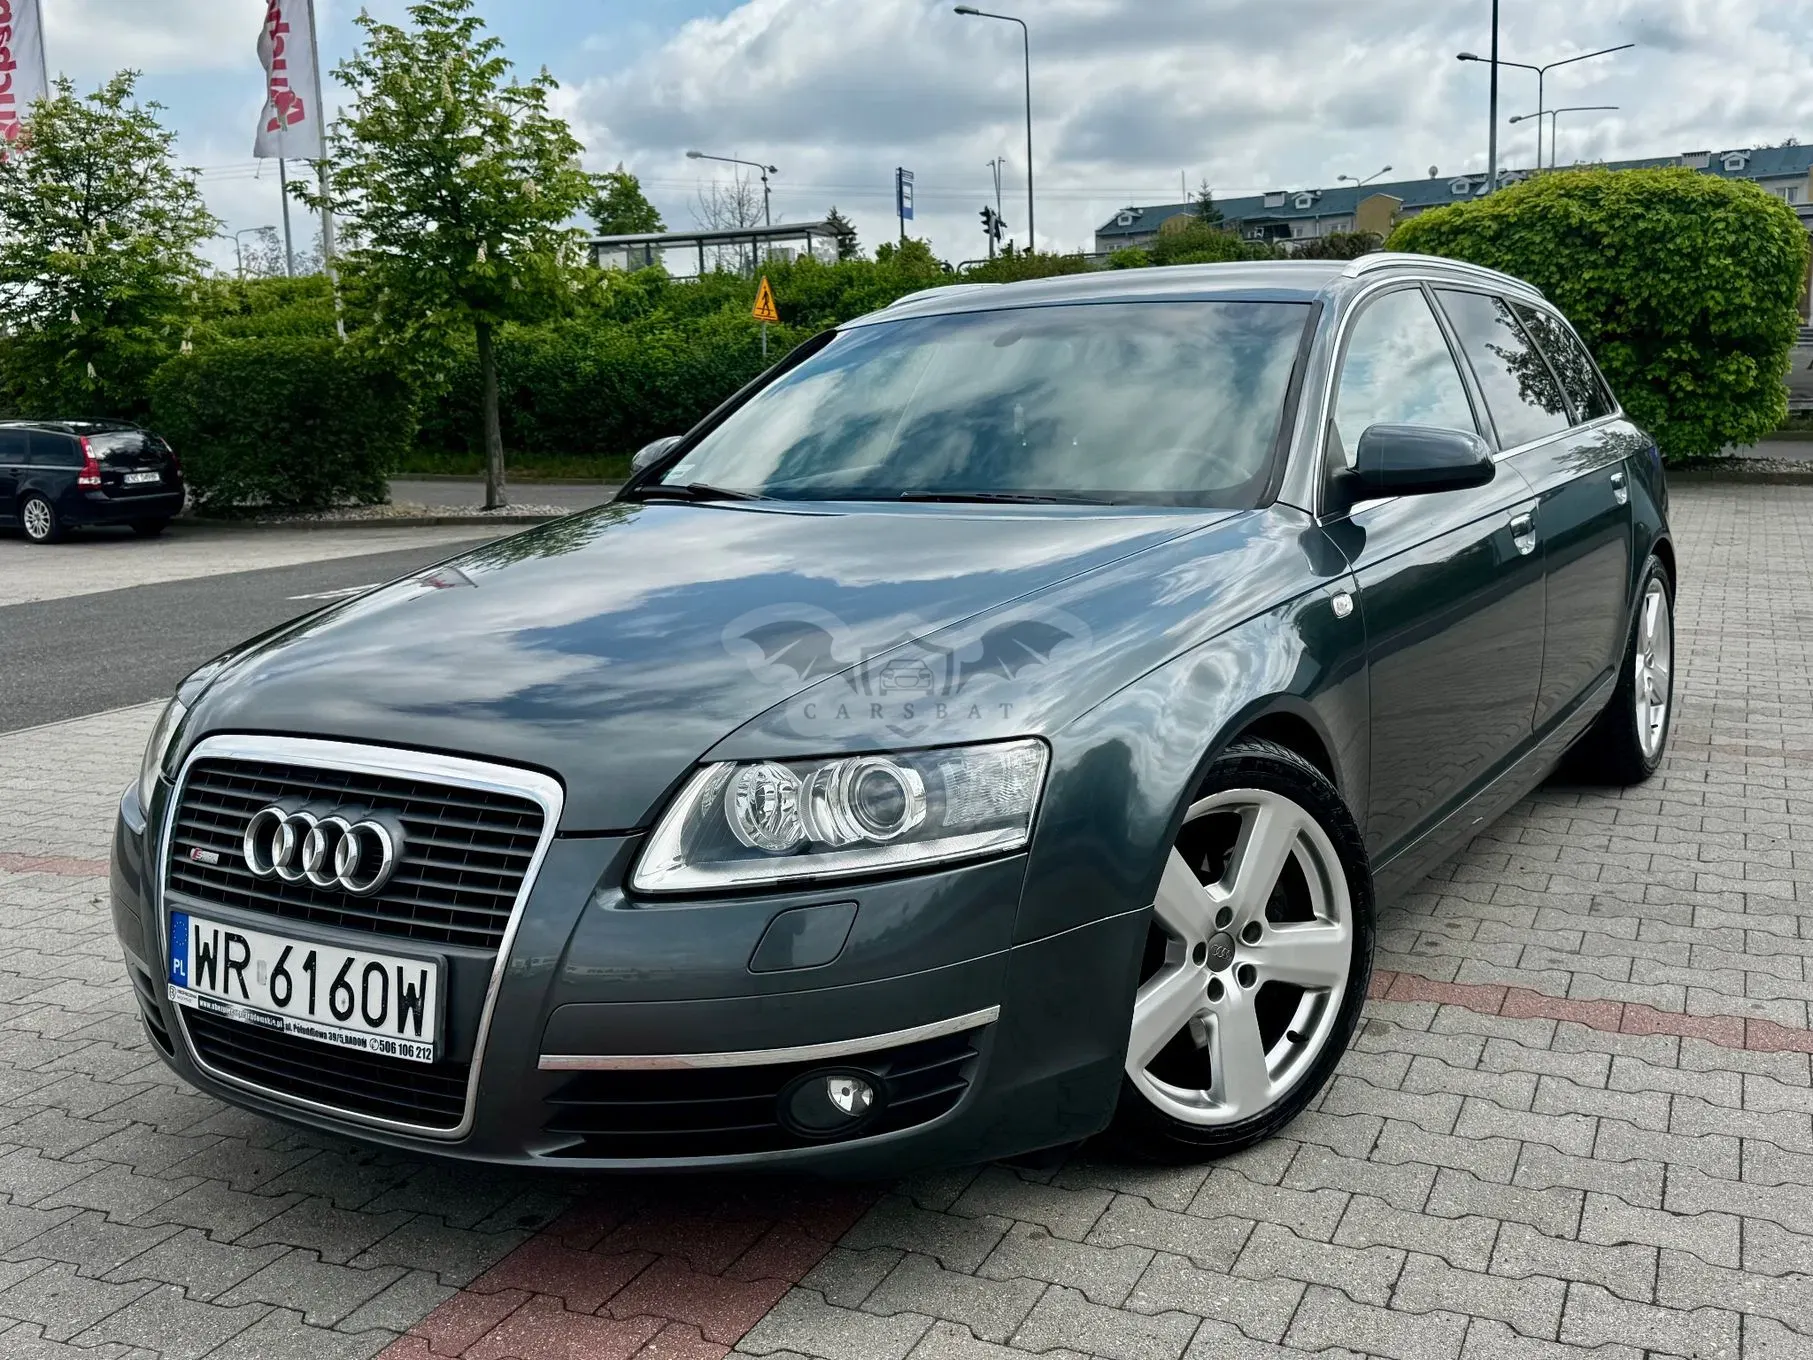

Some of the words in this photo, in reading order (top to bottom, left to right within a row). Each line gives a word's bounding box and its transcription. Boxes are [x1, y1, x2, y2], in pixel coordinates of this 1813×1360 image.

[173, 958, 186, 977] PL
[194, 924, 250, 1000] WR
[270, 944, 428, 1037] 6160W
[379, 1039, 397, 1055] 506
[397, 1043, 414, 1058] 106
[415, 1047, 432, 1061] 212
